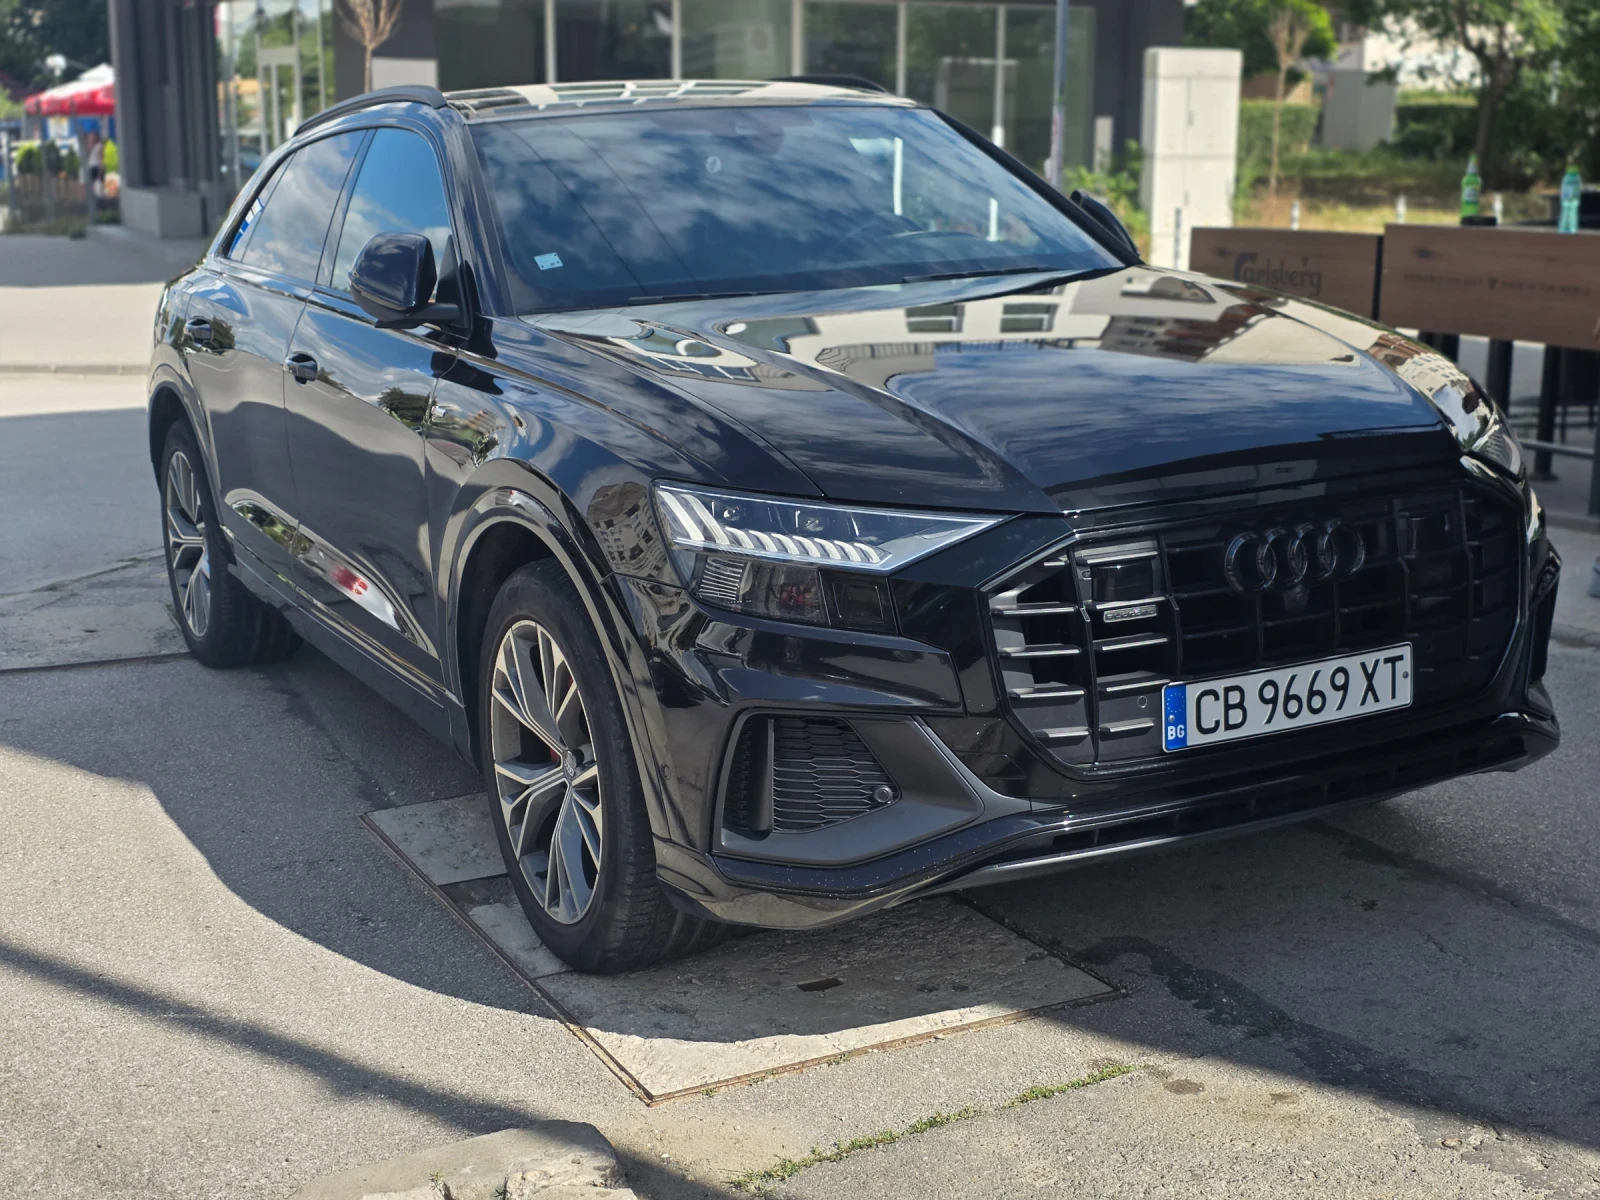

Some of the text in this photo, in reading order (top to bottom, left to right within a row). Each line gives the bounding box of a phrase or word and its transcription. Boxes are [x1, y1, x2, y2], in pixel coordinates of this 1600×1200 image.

[1233, 252, 1322, 298] Carlsberg
[1195, 654, 1404, 735] CB 9669 XT
[1167, 724, 1185, 740] BG
